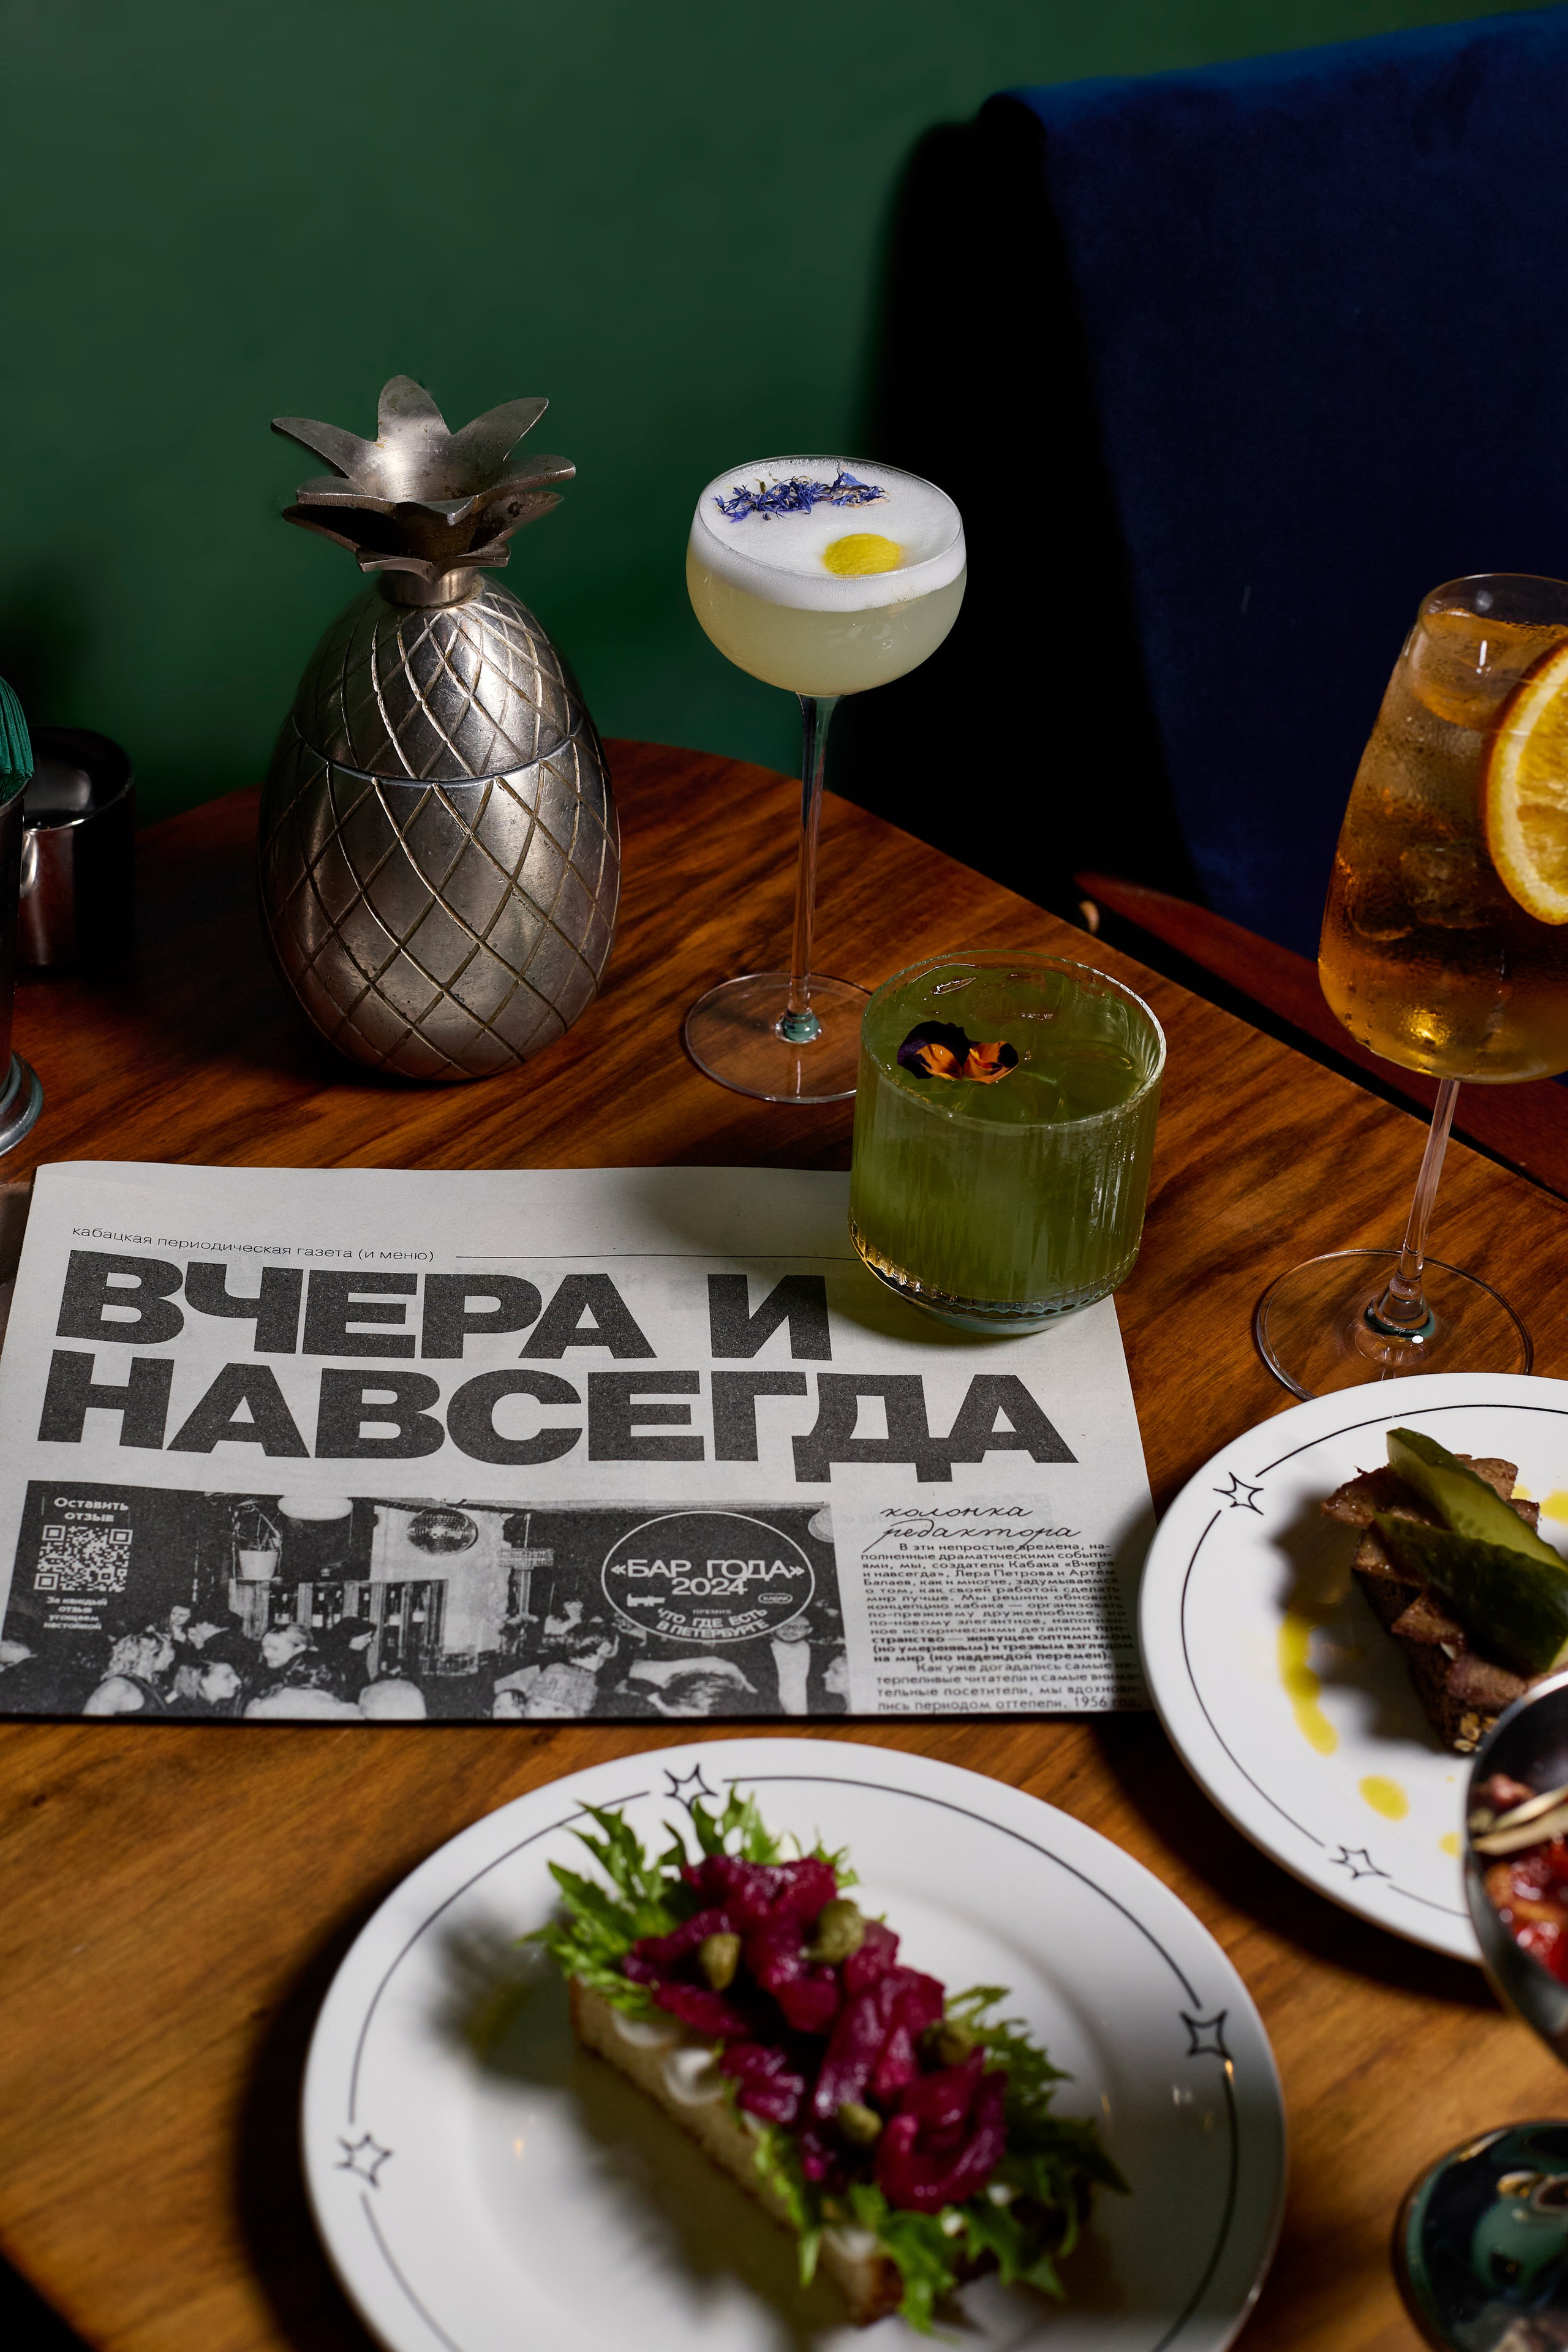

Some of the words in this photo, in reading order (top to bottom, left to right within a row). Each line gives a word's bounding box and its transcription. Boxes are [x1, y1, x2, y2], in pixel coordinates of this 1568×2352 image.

[72, 1227, 152, 1244] кабацкая
[157, 1237, 291, 1254] периодическая
[297, 1248, 352, 1258] газета
[358, 1249, 374, 1261] (и
[379, 1250, 434, 1262] меню)
[56, 1250, 655, 1359] ВЧЕРА
[708, 1274, 832, 1361] И
[38, 1349, 1078, 1483] НАВСЕГДА
[54, 1497, 129, 1511] Оставить
[64, 1512, 115, 1522] отзыв
[880, 1506, 1033, 1517] колонка
[862, 1518, 1081, 1554] редактора
[938, 1544, 1015, 1553] непростые
[1057, 1551, 1112, 1559] событи-
[611, 1559, 692, 1578] «БАР
[707, 1559, 805, 1581] ГОДА»
[1009, 1559, 1059, 1569] Кабака
[1065, 1559, 1115, 1569] «Вчера
[955, 1569, 991, 1578] Лера
[993, 1569, 1054, 1578] Петрова
[671, 1577, 748, 1596] 2024
[1016, 1578, 1118, 1587] задумываемся
[996, 1585, 1058, 1594] работой
[657, 1607, 687, 1624] ЧТО
[692, 1618, 723, 1629] ГДЕ
[728, 1609, 768, 1627] ЕСТЬ
[656, 1619, 670, 1630] В
[670, 1618, 770, 1639] ПЕТЕРБУРГЕ
[872, 1636, 945, 1645] странство
[873, 1644, 896, 1654] (но
[1004, 1643, 1065, 1652] трезвым
[1067, 1642, 1134, 1651] взглядом
[895, 1654, 925, 1664] мир
[929, 1653, 953, 1664] (но
[957, 1651, 1032, 1662] надеждой
[1074, 1695, 1107, 1708] 1956
